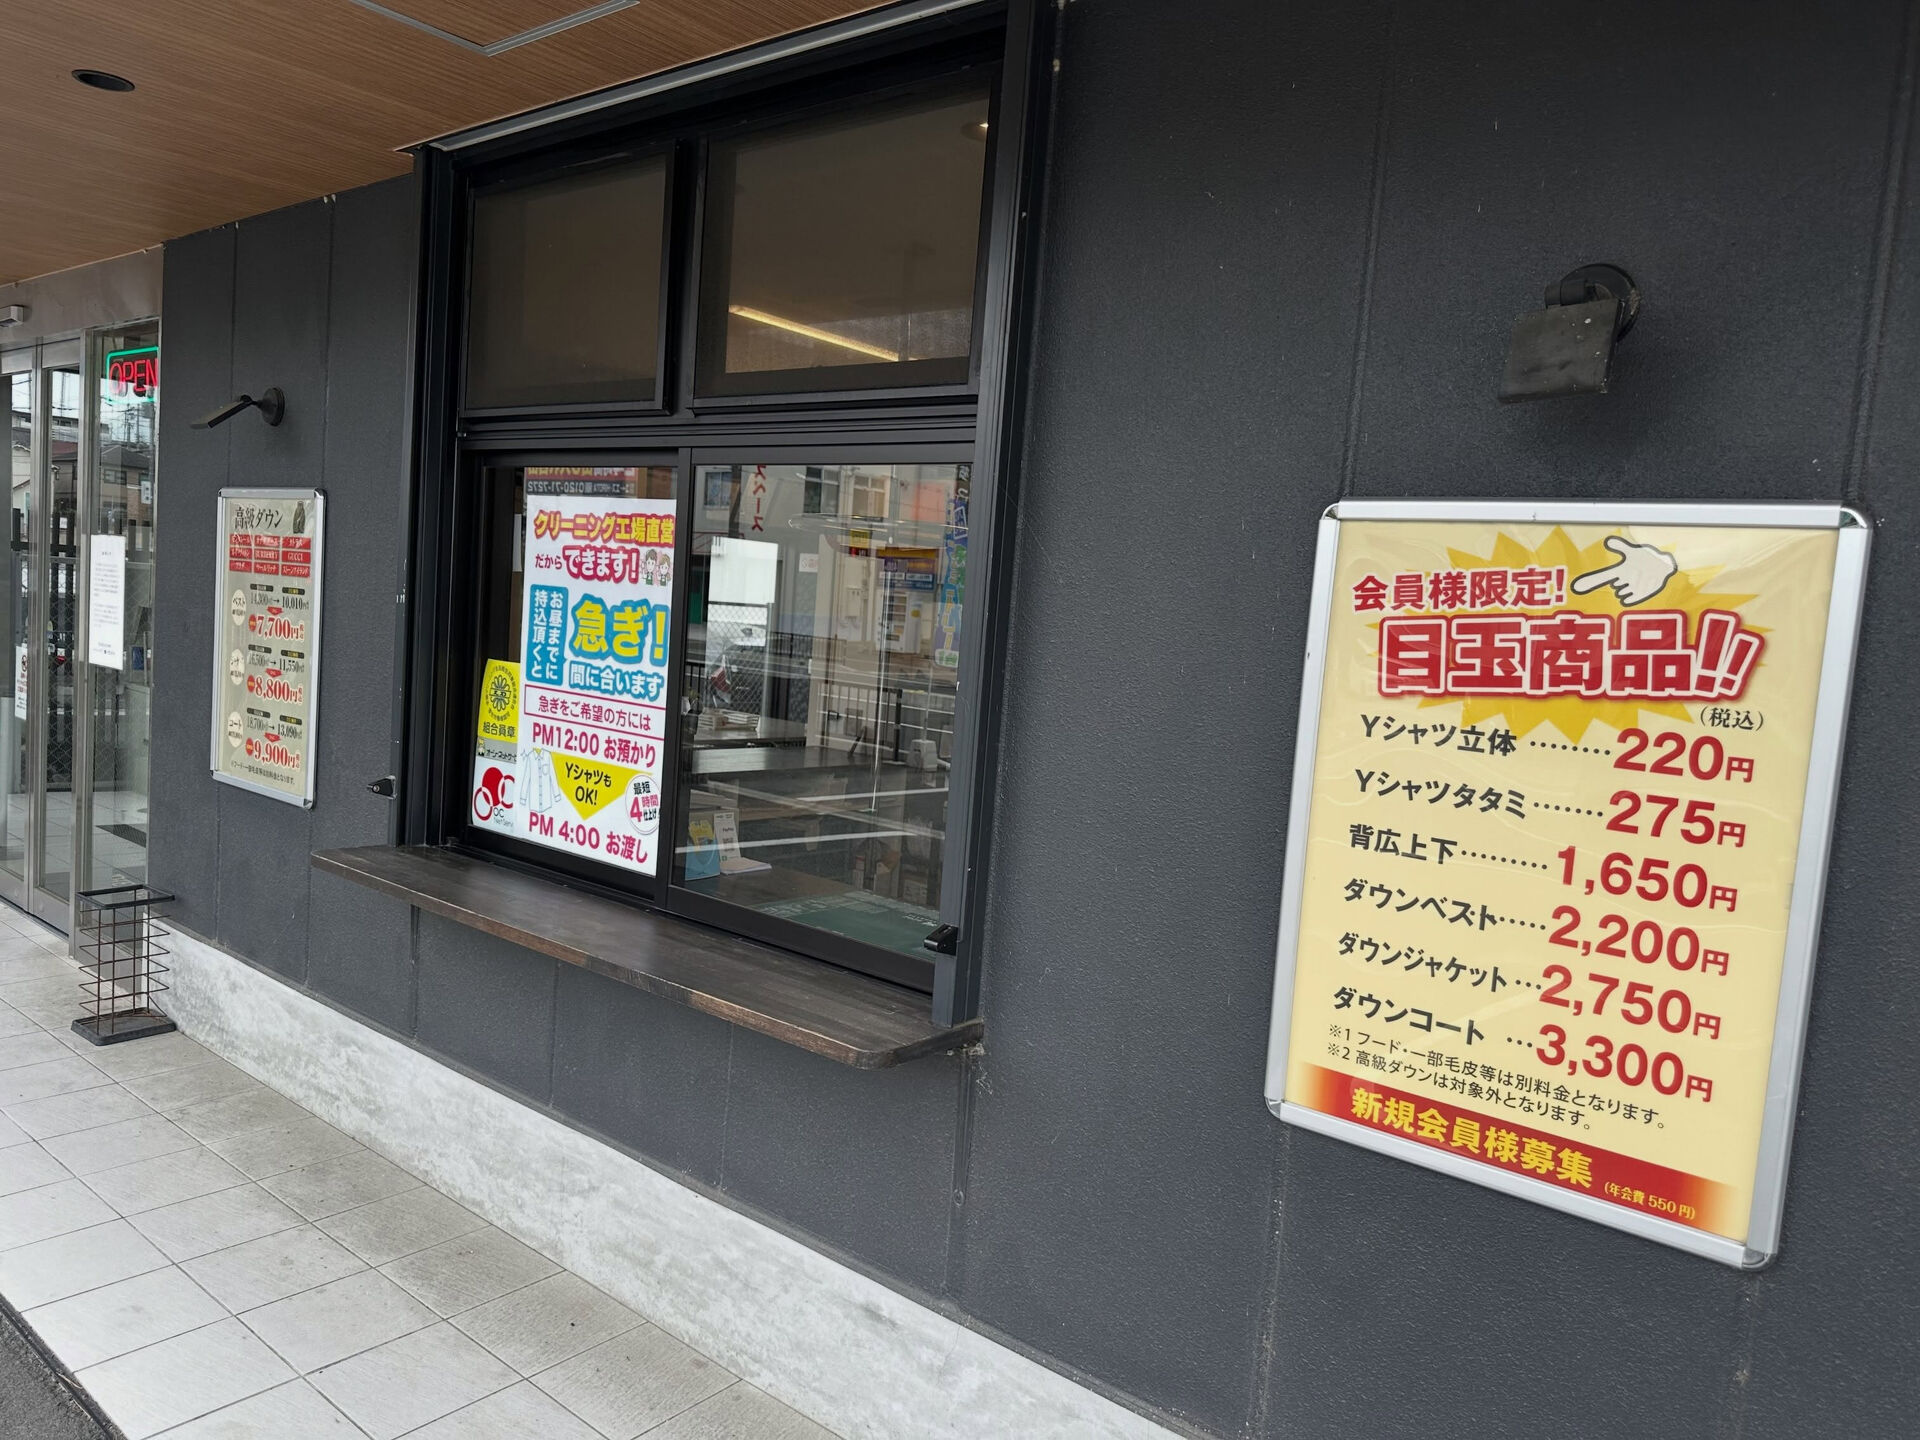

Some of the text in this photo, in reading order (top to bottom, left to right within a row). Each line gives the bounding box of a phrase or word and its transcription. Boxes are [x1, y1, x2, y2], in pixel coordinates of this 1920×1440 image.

[109, 358, 159, 394] OPEN
[234, 507, 284, 530] 高級ダウン
[534, 510, 675, 548] クリーニング工場直営
[535, 553, 562, 570] だから
[531, 588, 548, 678] 持込頂くと
[545, 590, 564, 681] お昼までに
[569, 662, 664, 701] 間に合います
[483, 721, 516, 739] 組合員章
[538, 695, 651, 731] 急ぎをご希望の方には
[532, 722, 656, 768] PM12:00 お預かり
[1361, 714, 1755, 784] Yシャツ立体 220円
[565, 762, 612, 788] Yシャツも
[633, 781, 651, 795] 最短
[575, 785, 598, 806] OK!
[1355, 769, 1746, 848] Yシャツタタミ 275円
[606, 831, 648, 864] お渡し
[1348, 824, 1739, 912] 背広上下 1,650円
[1343, 878, 1730, 976] ダウンベスト 2,200円
[1337, 931, 1722, 1041] ダウンジャケット 2,750円
[1333, 986, 1714, 1102] ダウンコート 3,300円
[1351, 1086, 1593, 1189] 新規会員様募集
